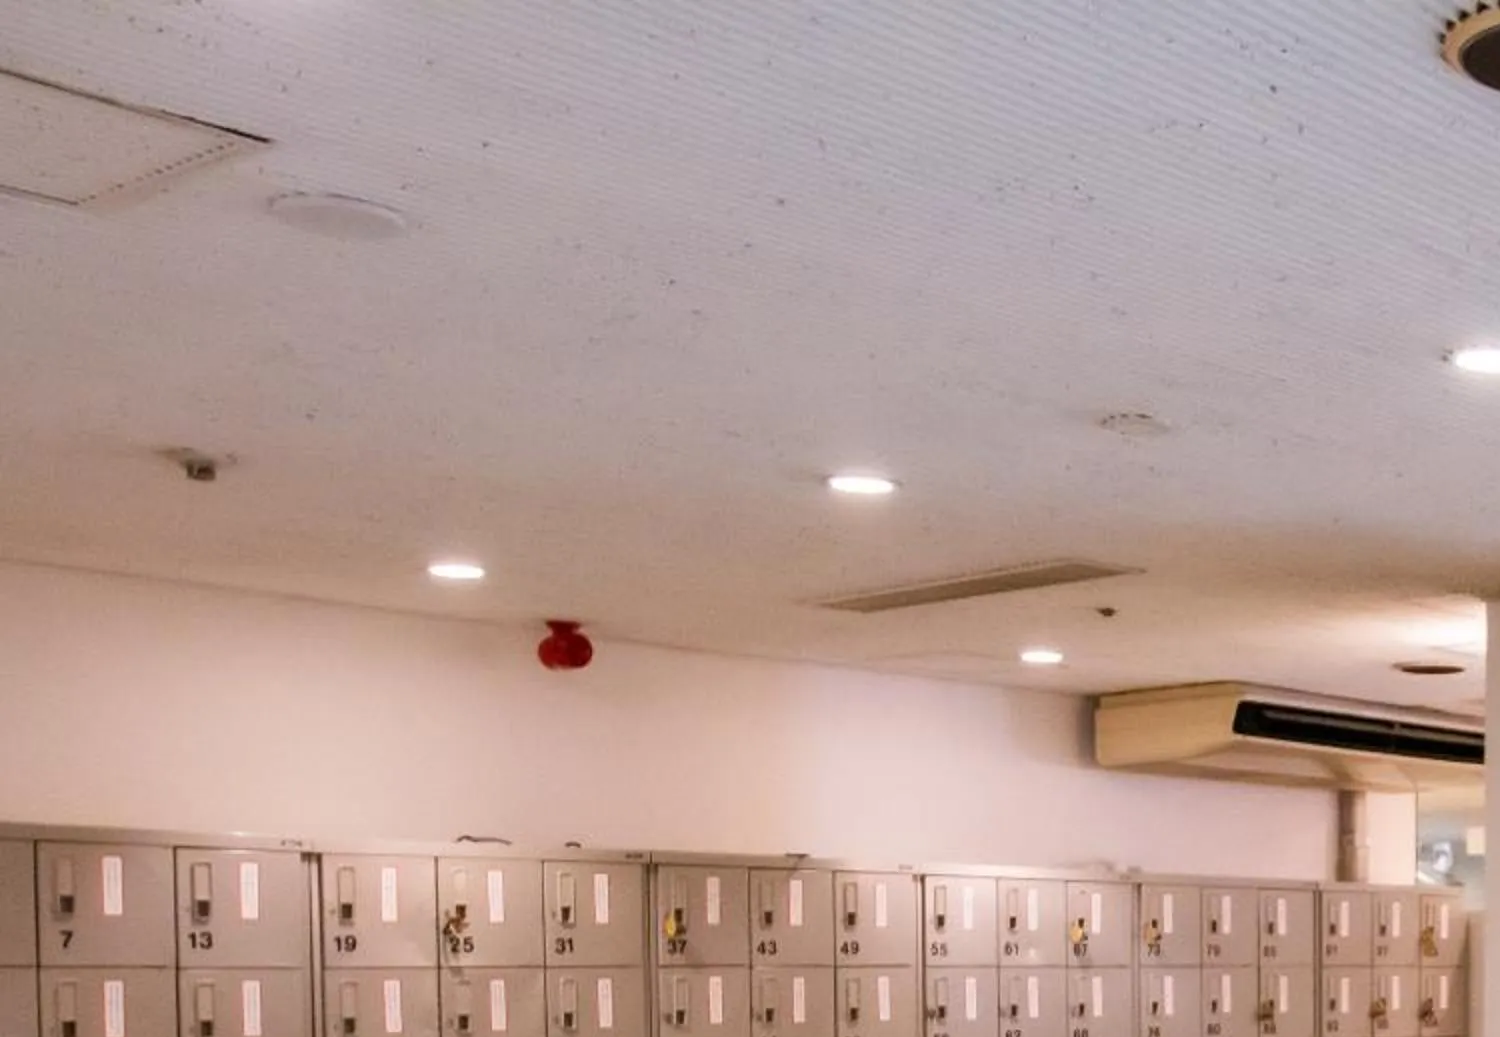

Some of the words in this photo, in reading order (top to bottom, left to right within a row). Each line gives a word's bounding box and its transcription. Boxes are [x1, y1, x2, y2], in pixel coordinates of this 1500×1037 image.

[60, 931, 72, 949] 7
[189, 932, 212, 949] 13
[335, 937, 356, 953] 19
[451, 937, 474, 953] 25
[555, 938, 574, 953] 31
[668, 941, 686, 955] 37
[757, 942, 777, 955] 43
[841, 942, 859, 955] 49
[931, 944, 947, 956] 55
[1005, 944, 1020, 956] 61
